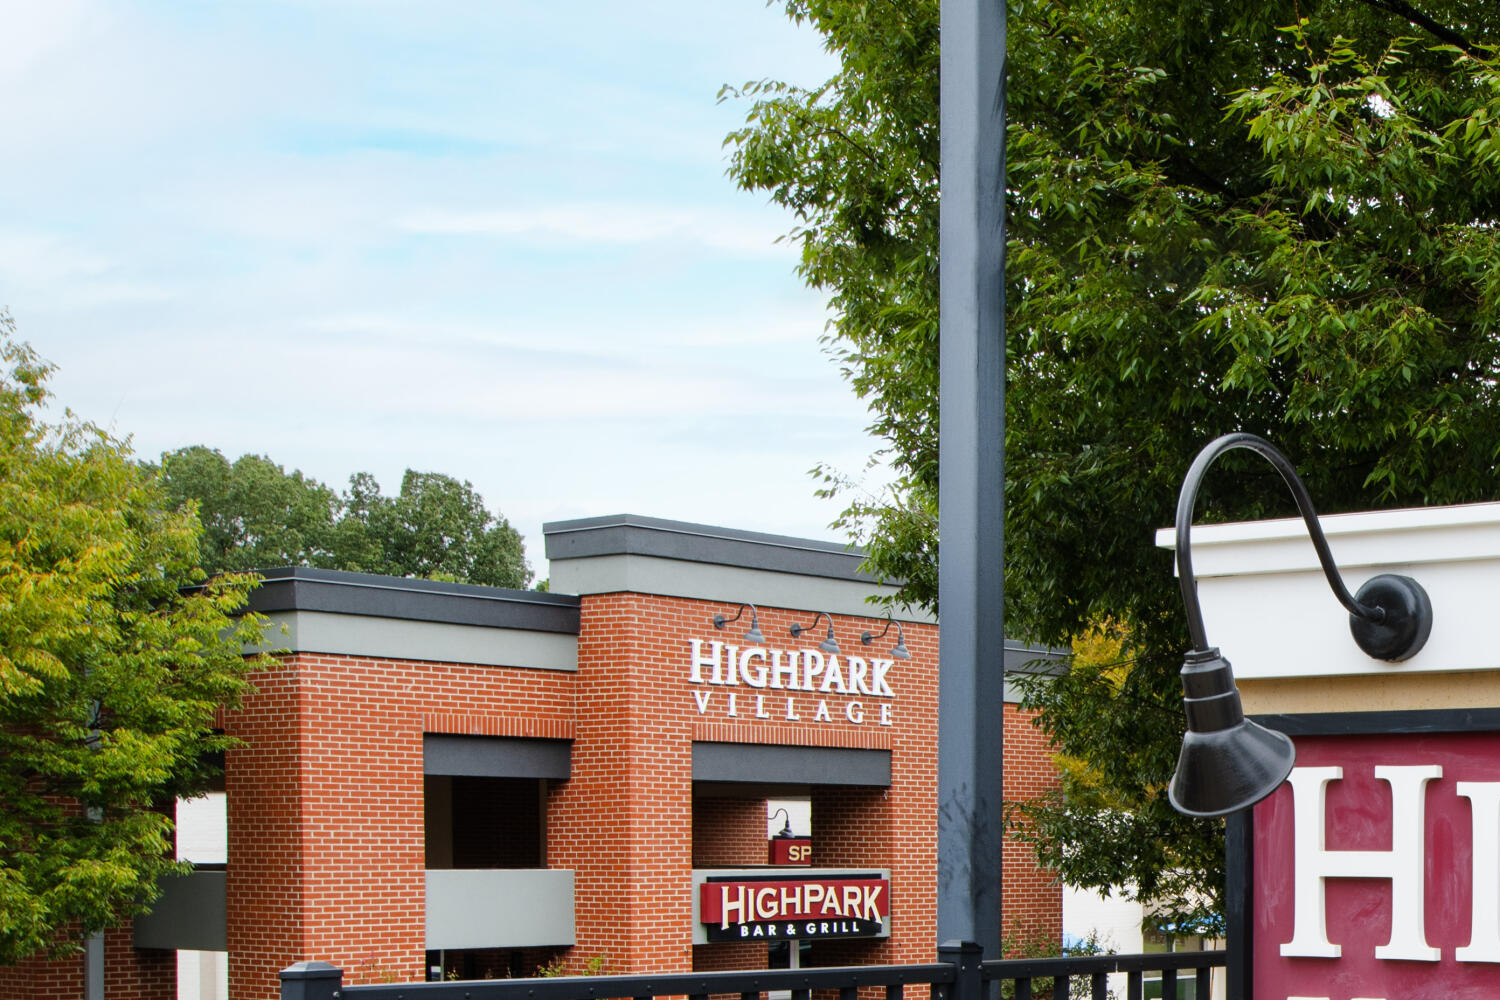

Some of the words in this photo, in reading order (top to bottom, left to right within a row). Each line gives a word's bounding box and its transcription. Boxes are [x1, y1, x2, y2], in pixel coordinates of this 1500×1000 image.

[688, 638, 895, 697] HIGHPARK
[691, 690, 893, 726] VILLAGE
[721, 884, 883, 931] HIGHPARK
[740, 924, 776, 937] BAR
[786, 924, 796, 935] &
[805, 921, 860, 935] GRILL
